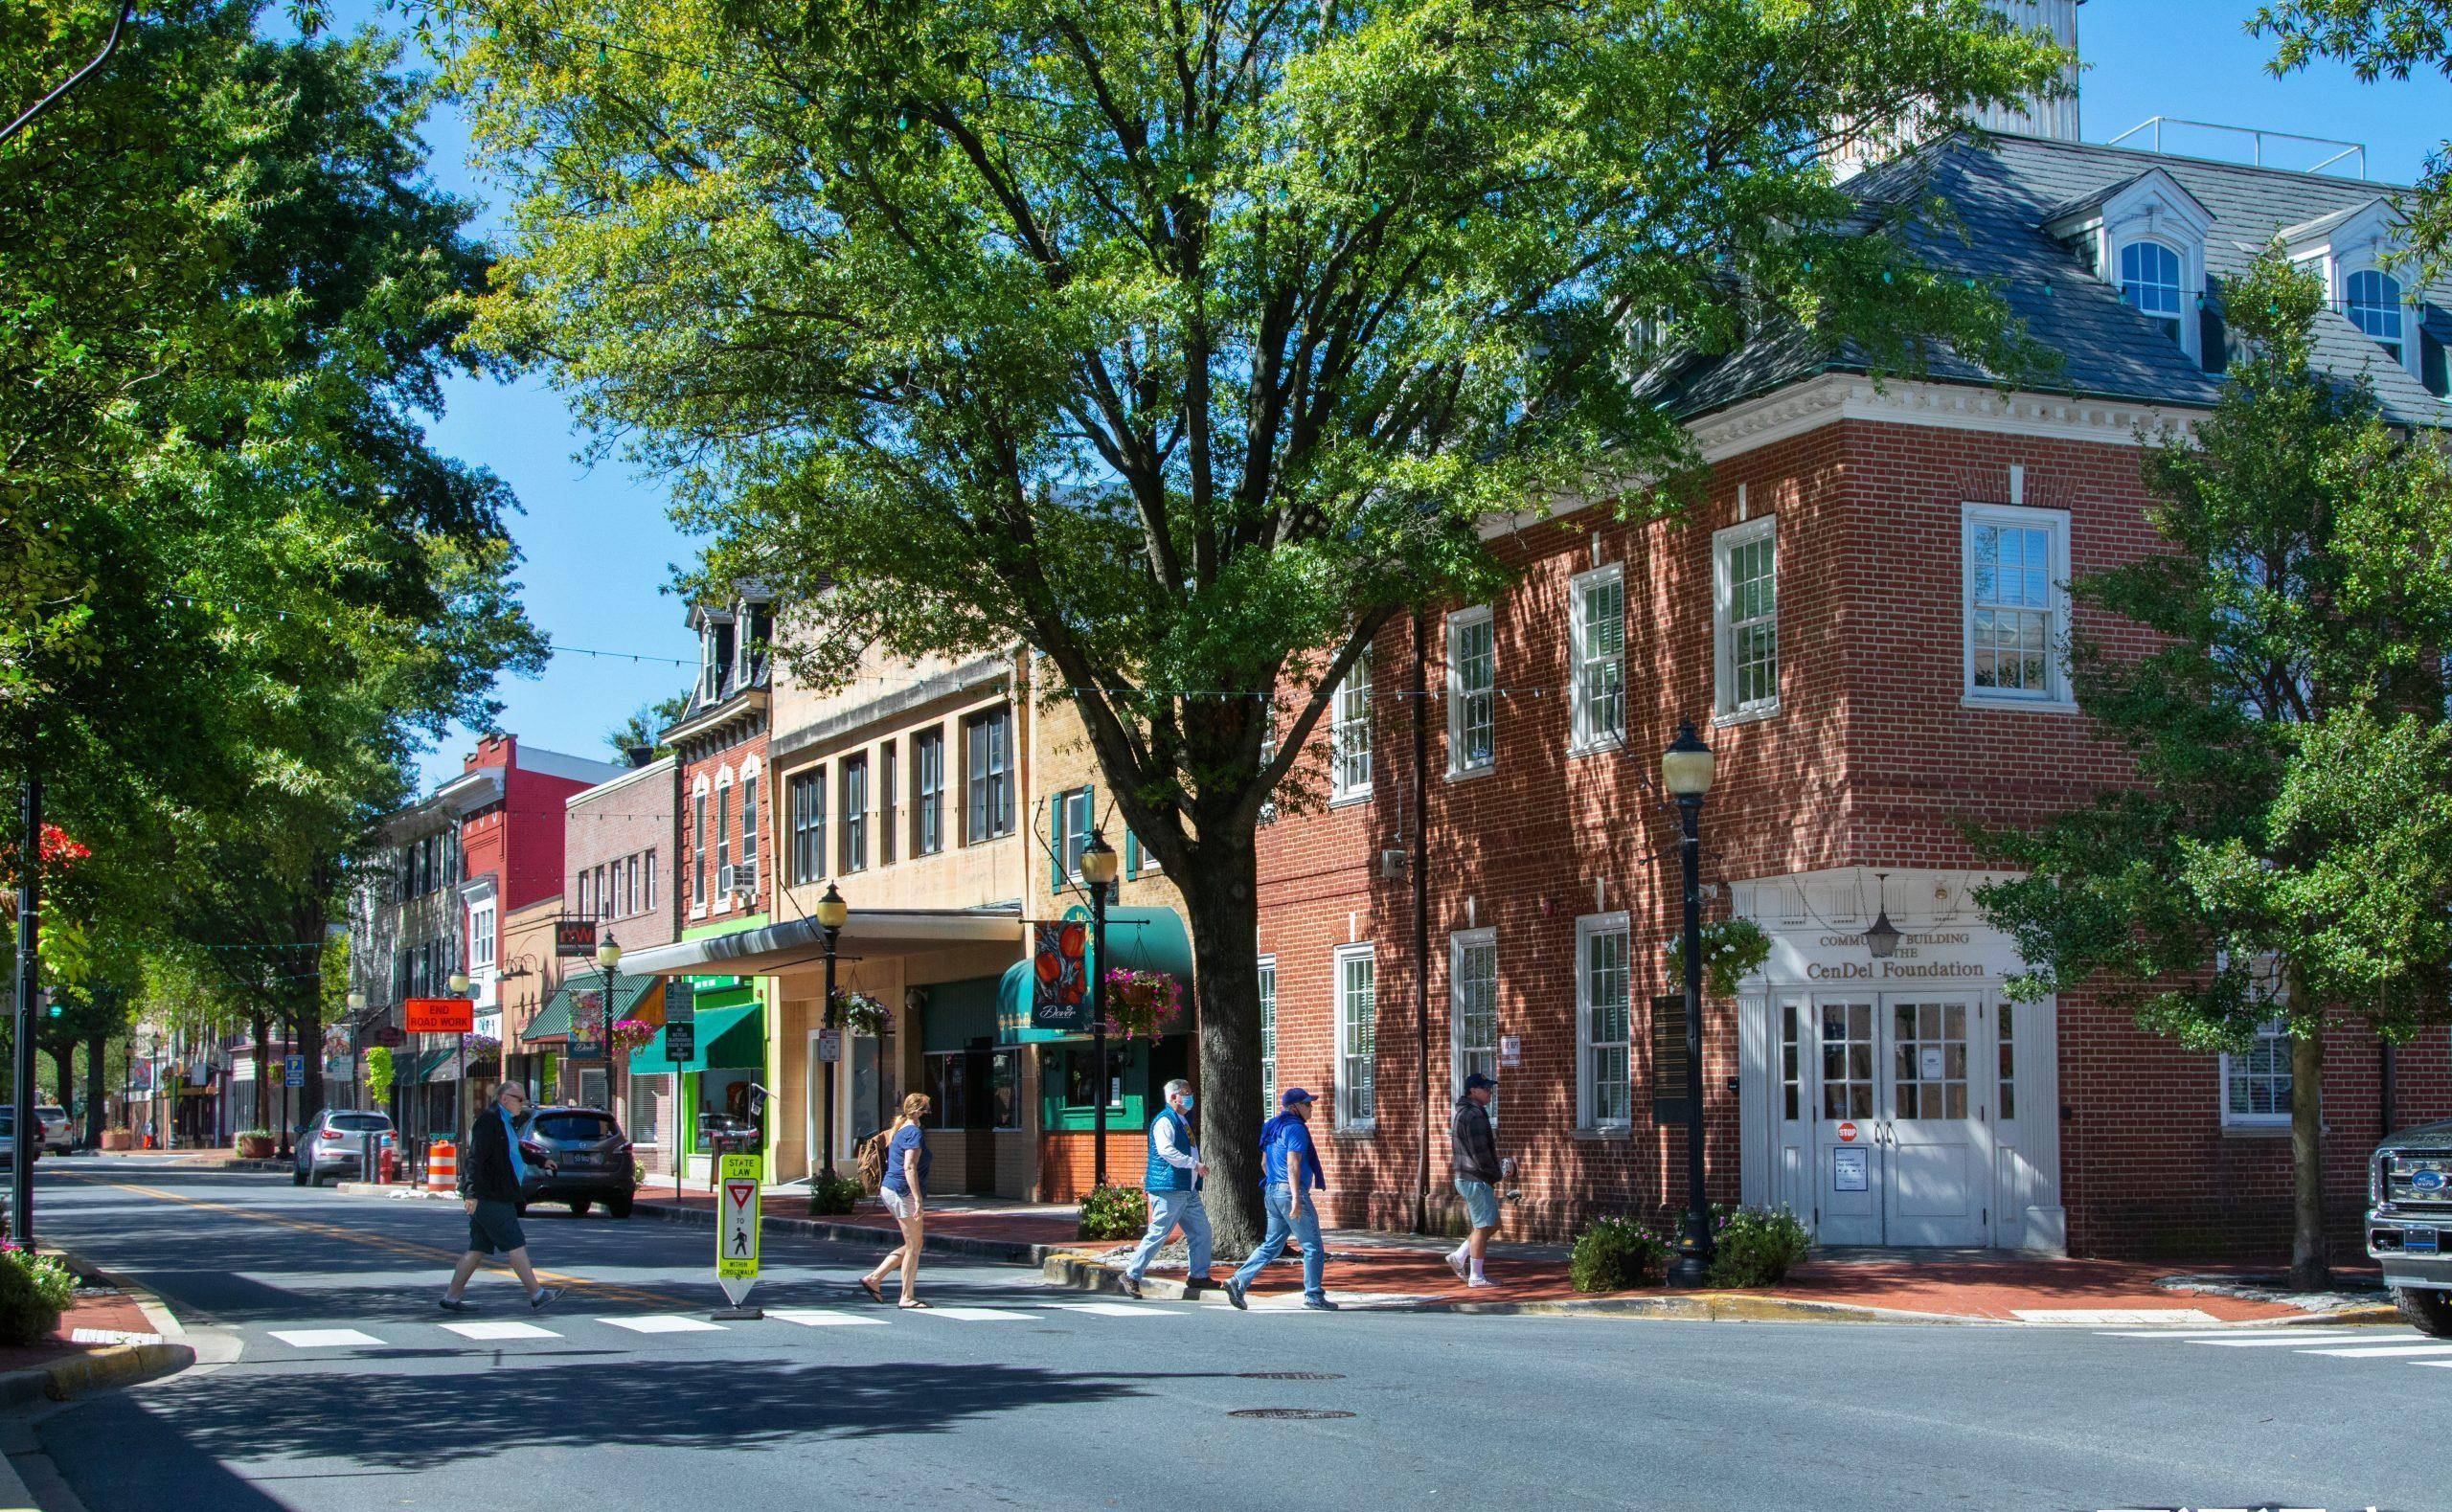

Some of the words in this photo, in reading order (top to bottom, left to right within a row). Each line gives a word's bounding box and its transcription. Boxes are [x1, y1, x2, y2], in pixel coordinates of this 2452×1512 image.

[1907, 934, 1969, 945] BUILDING
[1894, 948, 1918, 959] THE
[1806, 961, 1873, 979] CenDel
[1882, 961, 1985, 978] Foundation
[430, 1005, 449, 1014] END
[1039, 1004, 1076, 1019] Dover
[411, 1018, 437, 1027] ROAD
[441, 1018, 467, 1027] WORK
[1839, 1128, 1856, 1137] STOP
